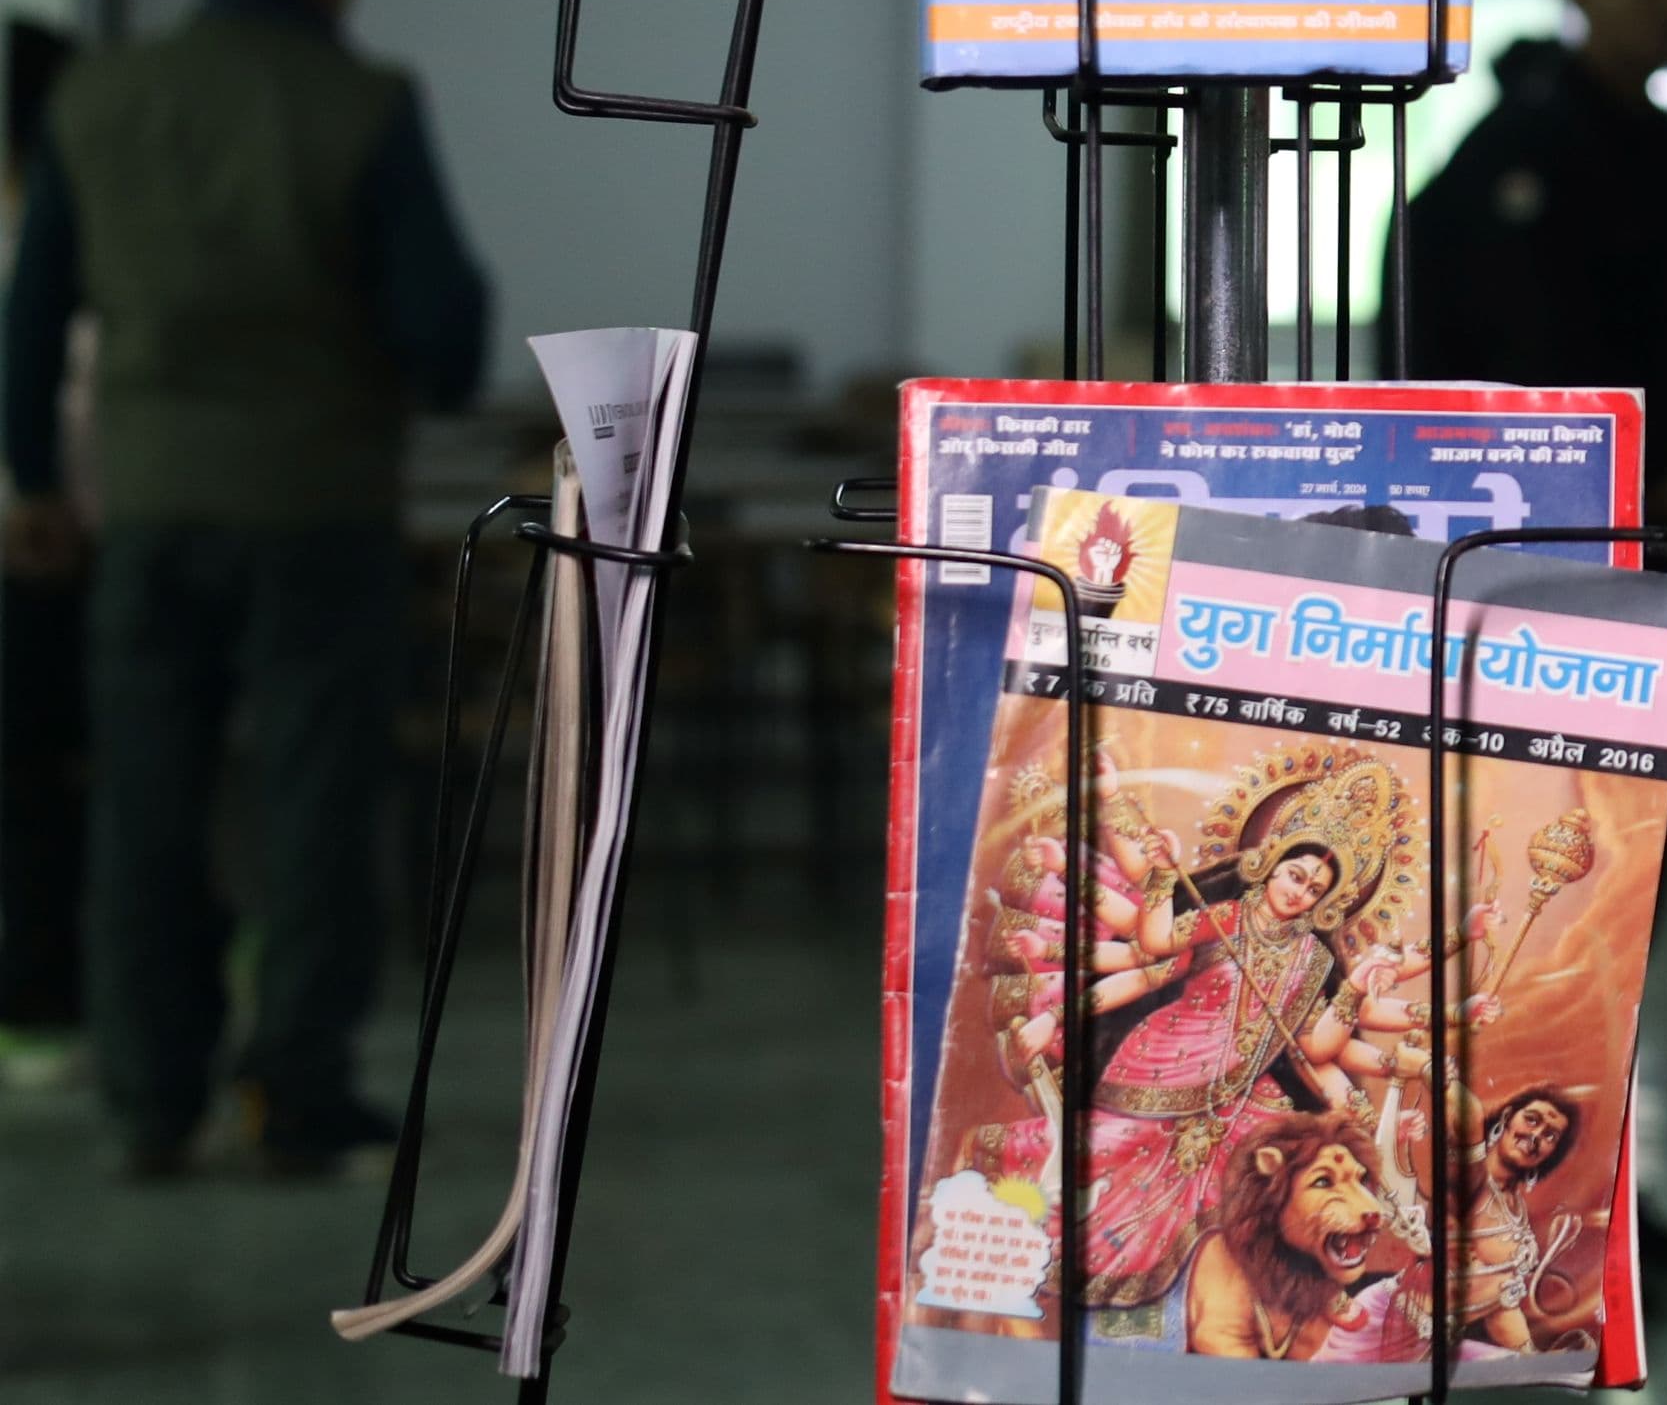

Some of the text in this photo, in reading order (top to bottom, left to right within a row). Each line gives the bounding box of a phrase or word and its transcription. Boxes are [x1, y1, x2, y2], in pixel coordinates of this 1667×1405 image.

[1322, 420, 1363, 439] मोदी
[1160, 441, 1176, 458] ने
[1300, 482, 1313, 494] 27
[1126, 630, 1156, 653] वर्ष
[1178, 595, 1661, 706] युग निर्माण योजना
[1114, 677, 1158, 705] प्रति
[1239, 696, 1307, 726] वार्षिक
[1528, 732, 1587, 763] अप्रैल
[1598, 747, 1655, 773] 2016
